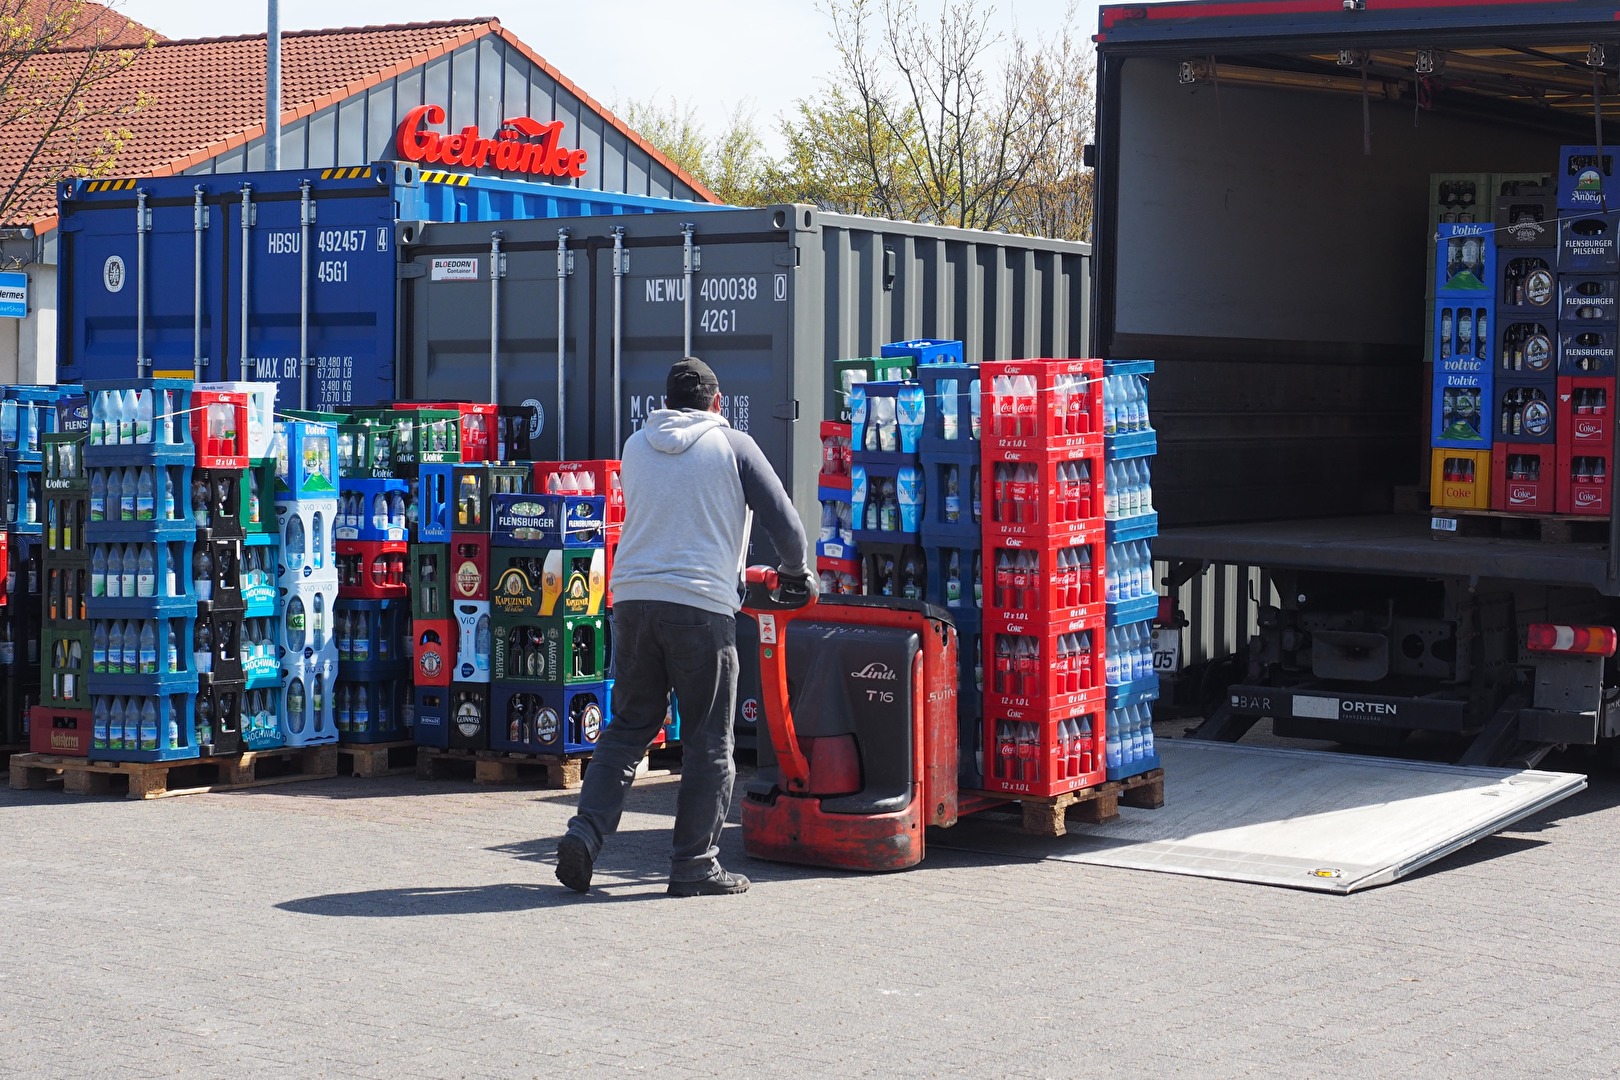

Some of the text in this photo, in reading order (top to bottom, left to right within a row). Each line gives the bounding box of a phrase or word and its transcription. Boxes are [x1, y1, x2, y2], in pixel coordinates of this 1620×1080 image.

[396, 104, 588, 178] Getränke
[1452, 225, 1482, 236] Volvic
[268, 229, 386, 254] HBSU 492457 4
[318, 261, 348, 282] 45G1
[646, 276, 785, 302] NEWU 400038 0
[0, 290, 24, 299] ermes
[700, 309, 736, 332] 42G1
[343, 357, 353, 367] KG
[1444, 358, 1481, 371] volvic
[256, 358, 300, 379] MAX. GR.
[343, 368, 352, 378] LB
[1004, 365, 1021, 374] Coke
[343, 380, 352, 391] KG
[1447, 375, 1478, 386] Volvic
[343, 392, 352, 402] LB
[734, 395, 749, 407] KGS
[733, 408, 749, 419] LBS
[64, 420, 88, 431] FLENS
[304, 424, 327, 435] Volvic
[733, 420, 749, 431] KGS
[1579, 422, 1596, 433] Coke
[396, 453, 444, 462] olvic Volvic
[1004, 451, 1022, 460] Coke
[372, 469, 393, 478] Volvic
[46, 479, 70, 489] Volvic
[1447, 487, 1471, 498] Coke
[1513, 489, 1531, 499] Coke
[1579, 491, 1596, 501] Coke
[499, 517, 554, 527] FLENSBURGER
[569, 519, 602, 528] FLENSBURGER
[1006, 537, 1023, 547] Coke
[495, 595, 532, 607] KAPUZINER
[461, 617, 475, 625] ViO
[1004, 612, 1010, 620] 12
[1007, 623, 1024, 633] Coke
[245, 657, 280, 669] HOCHWALD
[1002, 697, 1008, 706] 12
[1342, 701, 1397, 714] ORTEN
[1007, 709, 1024, 718] Coke
[457, 715, 479, 724] GUINNESS
[246, 731, 280, 741] HOCHWALD
[1002, 782, 1008, 790] 12
